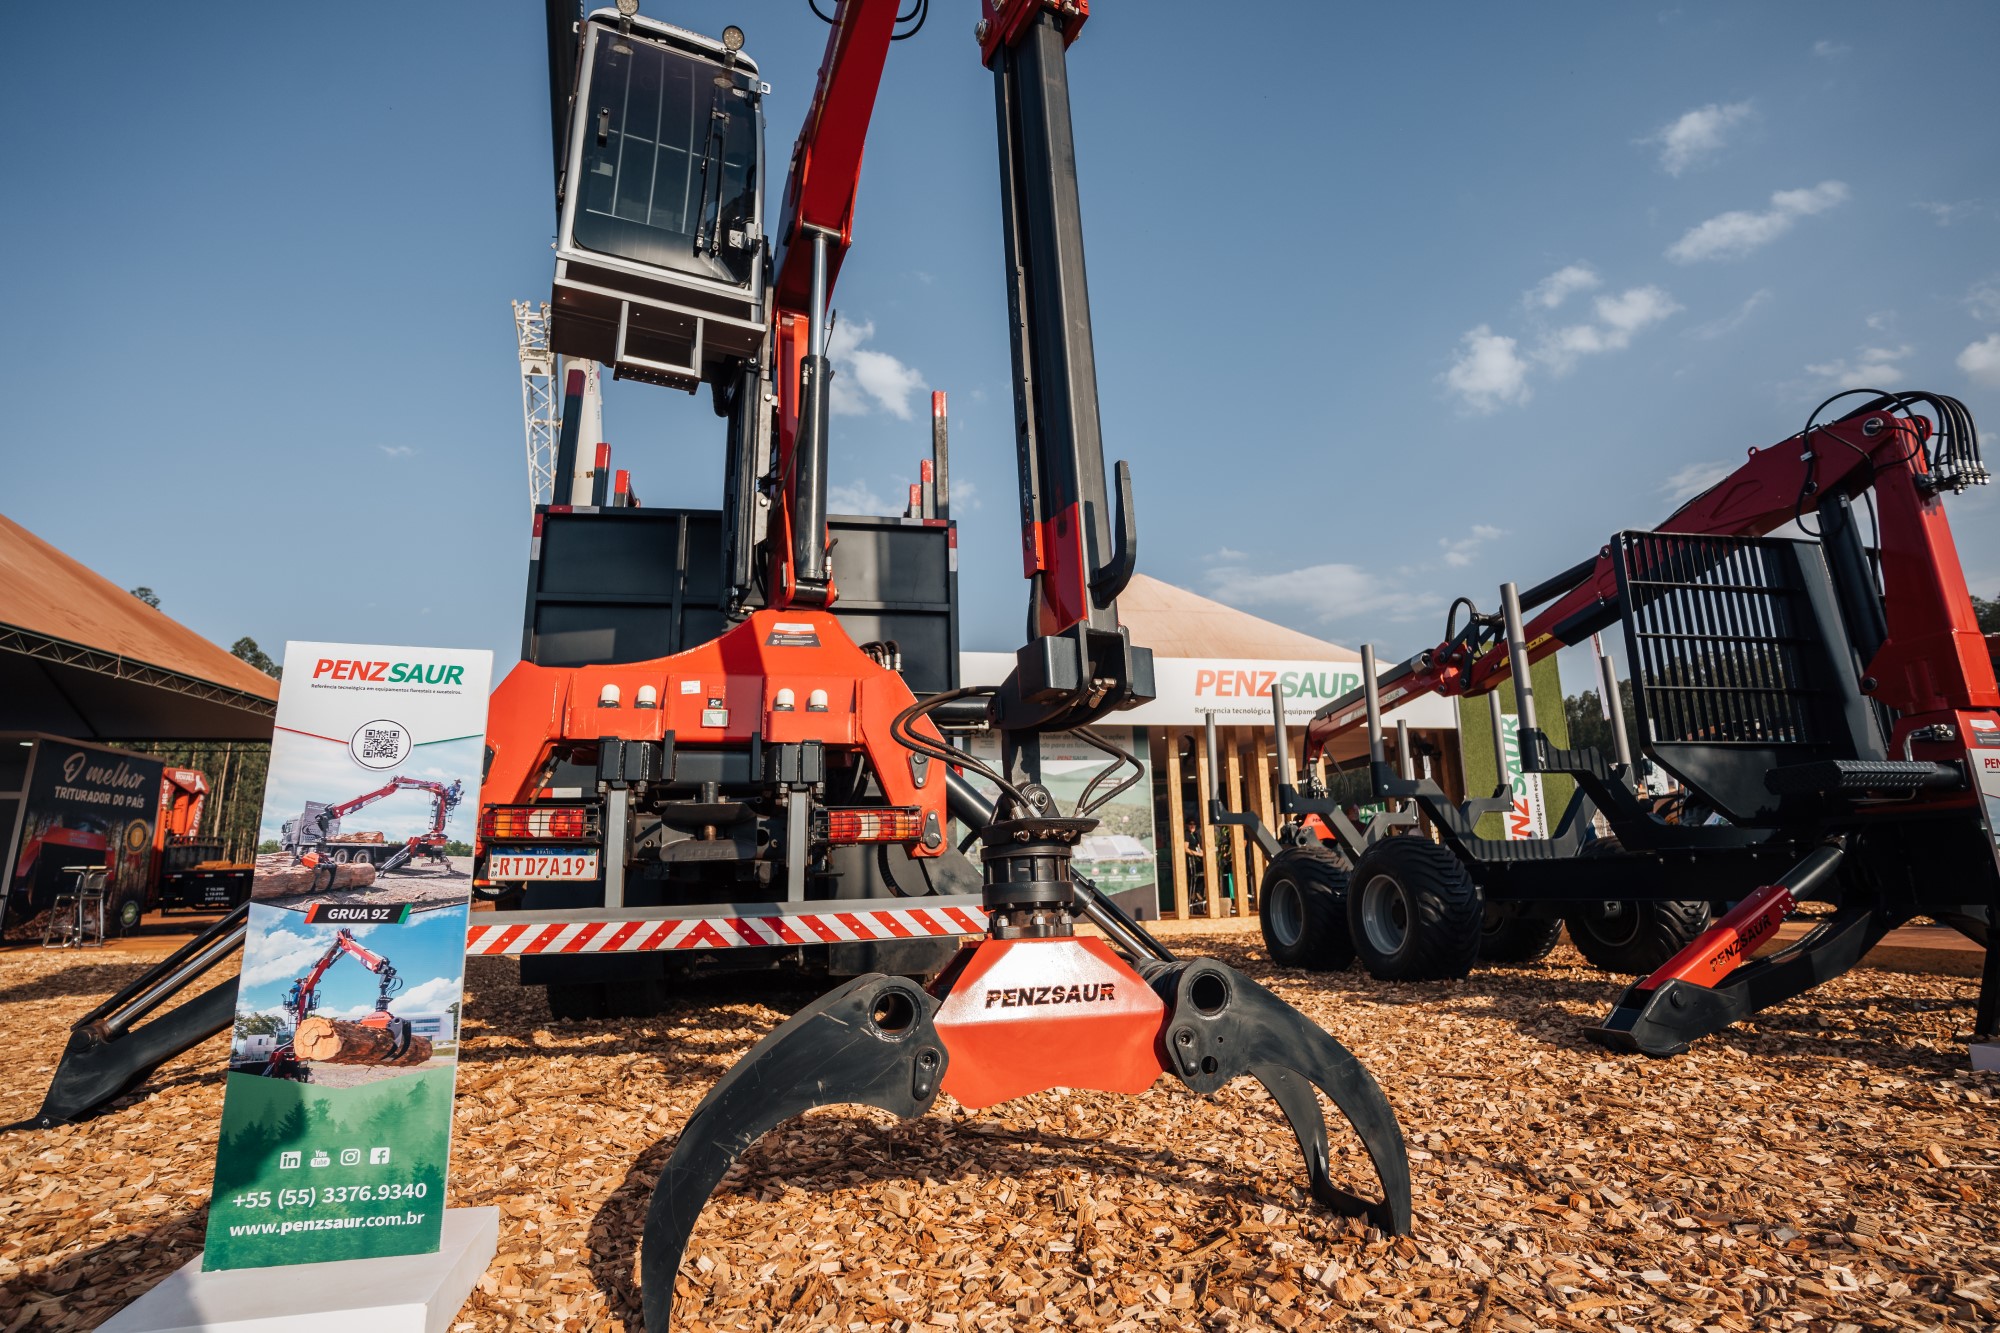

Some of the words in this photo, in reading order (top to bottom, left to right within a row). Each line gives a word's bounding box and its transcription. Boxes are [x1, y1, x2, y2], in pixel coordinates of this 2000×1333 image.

[313, 658, 465, 686] PENZSAUR
[1194, 669, 1359, 699] PENZSAUR
[1232, 708, 1271, 718] tecnológica
[63, 752, 86, 783] O
[86, 761, 146, 789] melhor
[55, 786, 111, 804] TRITURADOR
[112, 794, 124, 806] DO
[126, 794, 145, 808] PAÍS
[498, 857, 586, 876] RTD7A19
[327, 908, 368, 920] GRUA
[370, 908, 391, 920] 9Z
[1709, 914, 1773, 972] PENZSAUR
[985, 983, 1115, 1009] PENZSAUR
[232, 1191, 272, 1209] +55
[278, 1187, 316, 1209] (55)
[322, 1182, 427, 1204] 3376.9340
[229, 1211, 425, 1237] www.penzsaur.com.br
